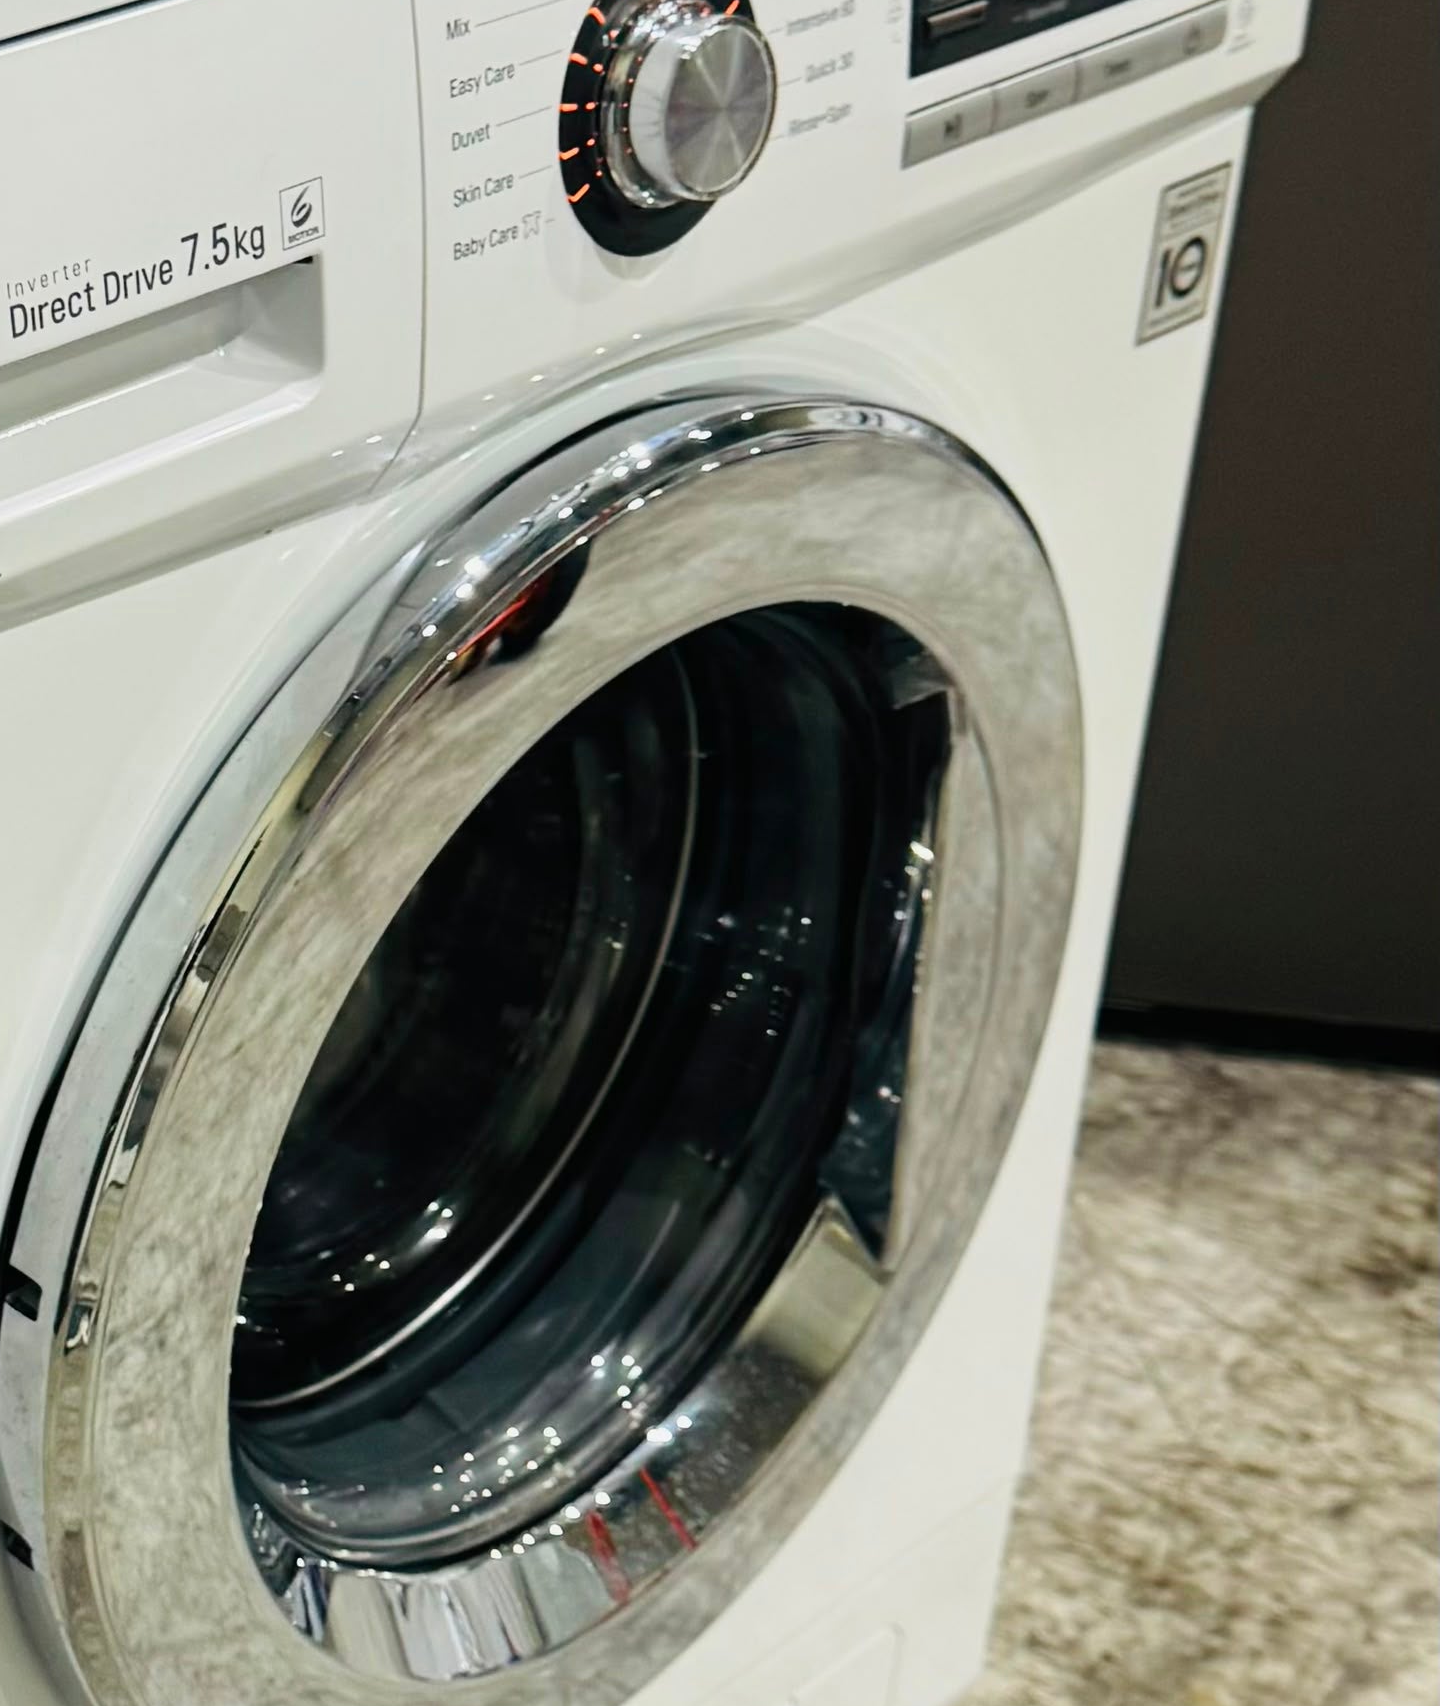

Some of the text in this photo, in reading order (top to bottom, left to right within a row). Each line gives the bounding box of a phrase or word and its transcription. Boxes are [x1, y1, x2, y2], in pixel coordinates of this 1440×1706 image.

[446, 18, 471, 40] Mix
[449, 63, 515, 99] Easy Care
[451, 123, 490, 151] Duvet
[453, 174, 514, 208] Skin Care
[453, 225, 518, 260] Baby Care
[6, 258, 92, 300] Inverter
[9, 222, 266, 339] Direct Drive 7.5kg
